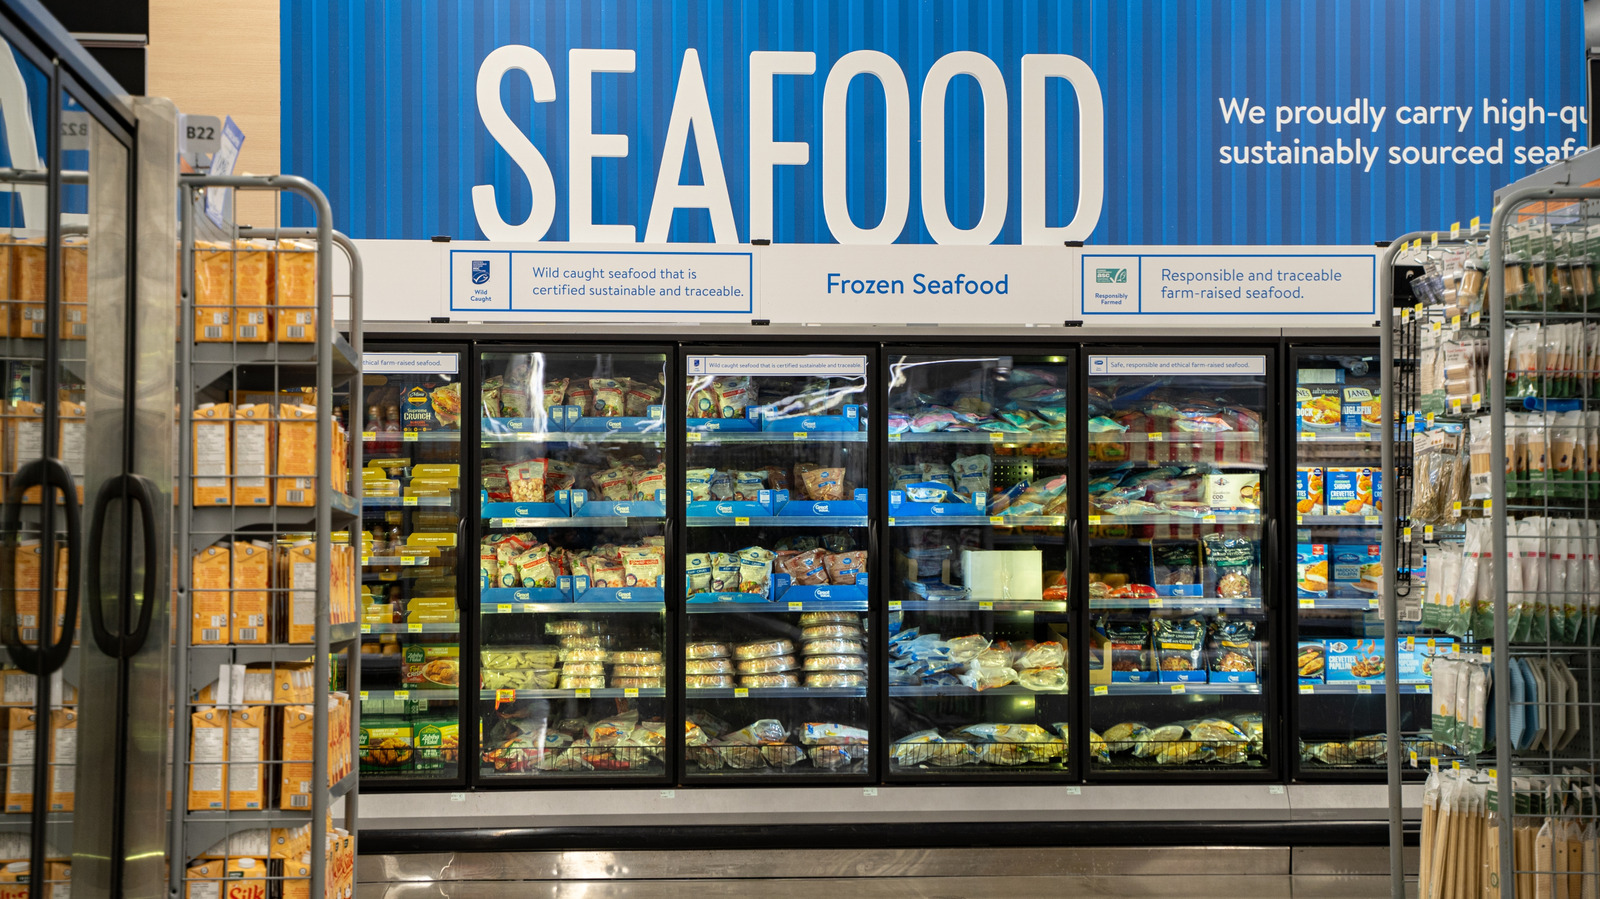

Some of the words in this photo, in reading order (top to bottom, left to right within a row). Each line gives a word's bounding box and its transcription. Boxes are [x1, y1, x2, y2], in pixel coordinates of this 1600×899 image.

[1219, 98, 1265, 124] We
[1276, 98, 1386, 132] proudly
[1396, 106, 1472, 132] carry
[187, 126, 214, 140] B22
[471, 45, 1104, 244] SEAFOOD
[1220, 138, 1379, 172] sustainably
[1389, 138, 1502, 164] sourced
[533, 267, 559, 278] Wild
[563, 268, 604, 281] caught
[609, 268, 656, 279] seafood
[660, 269, 684, 279] that
[688, 269, 697, 279] is
[1161, 268, 1244, 284] Responsible
[1248, 269, 1273, 281] and
[1277, 269, 1342, 281] traceable
[533, 284, 585, 295] certified
[589, 284, 655, 296] sustainable
[659, 285, 681, 296] and
[685, 286, 744, 297] traceable.
[827, 273, 904, 294] Frozen
[913, 273, 1009, 294] Seafood
[1161, 286, 1241, 298] farm-raised
[1246, 286, 1304, 298] seafood.
[1347, 390, 1366, 398] JANES
[404, 412, 431, 420] CRUNCH
[1342, 406, 1372, 414] AIGLEFIN
[1329, 655, 1356, 663] CREVETTES
[230, 885, 265, 899] Silk
